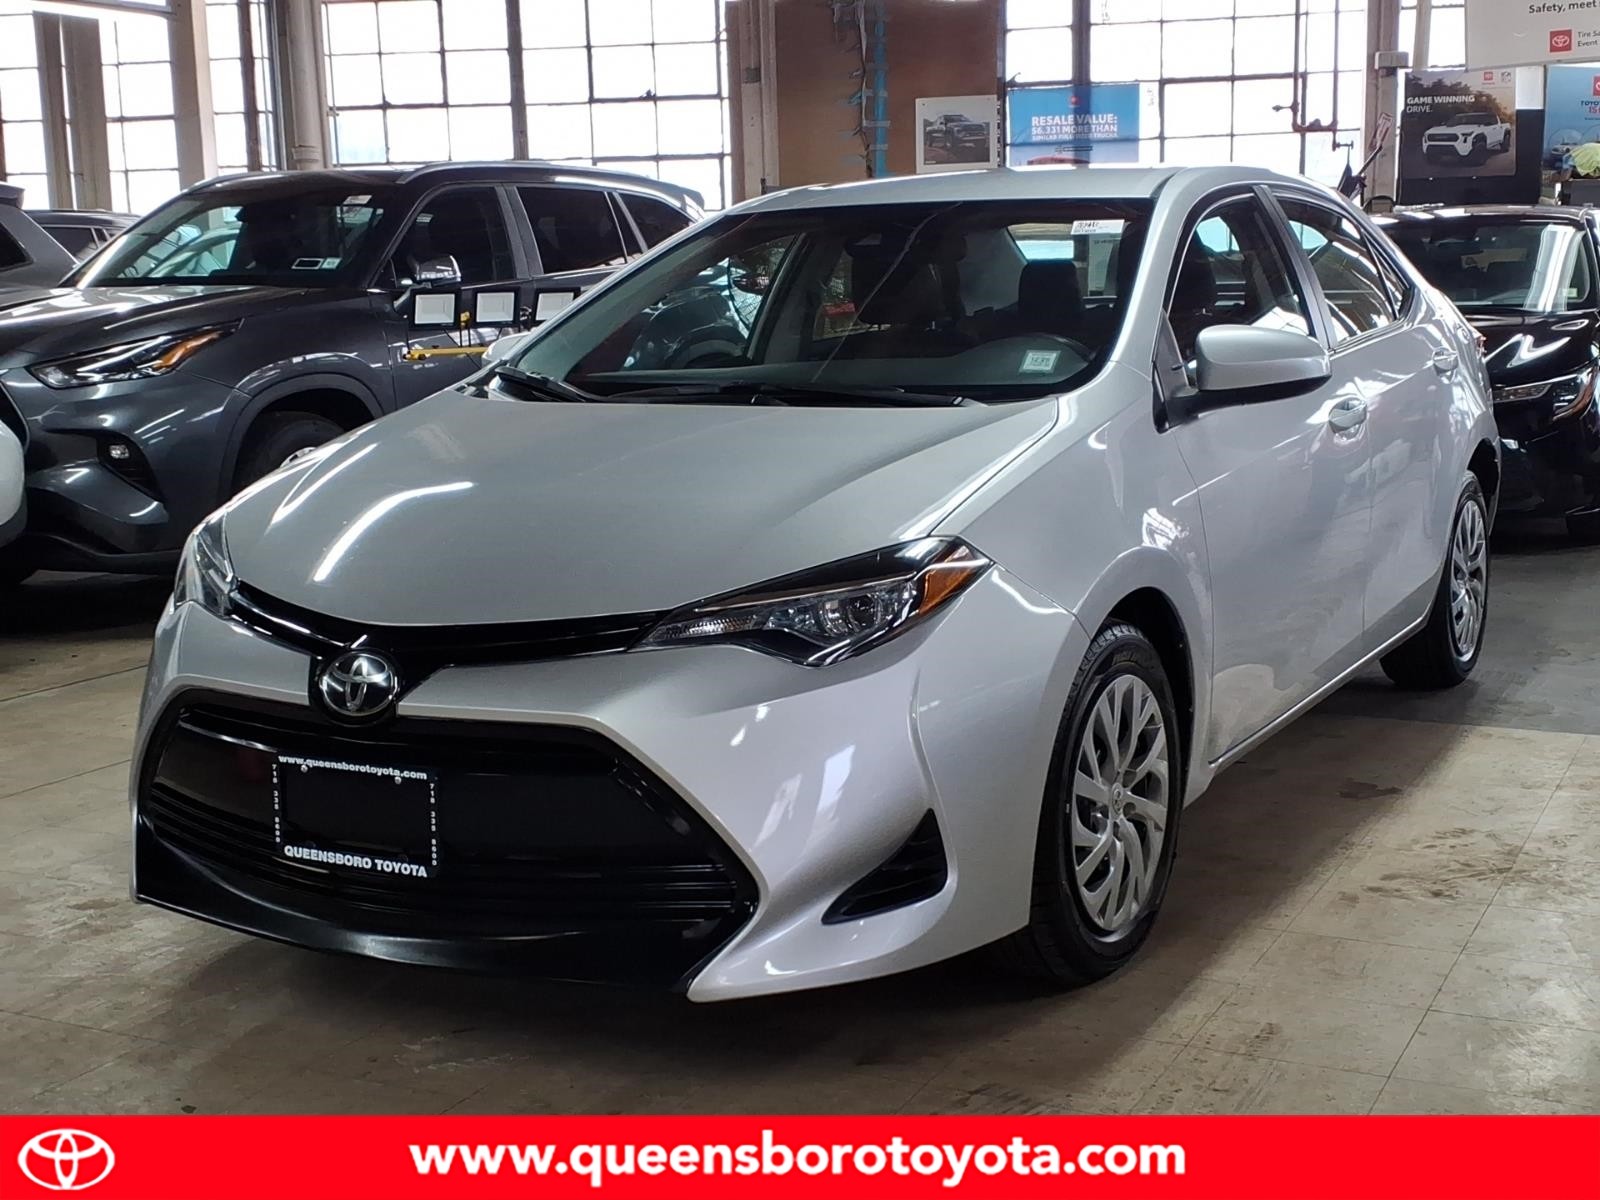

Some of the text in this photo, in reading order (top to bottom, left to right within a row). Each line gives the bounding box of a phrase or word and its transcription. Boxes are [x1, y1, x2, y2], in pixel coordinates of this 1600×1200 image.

[1528, 0, 1597, 14] Safety, meet
[1577, 39, 1598, 47] Event
[1406, 94, 1476, 105] GAME WINNING
[1406, 105, 1433, 113] DRIVE.
[1032, 113, 1118, 126] RESALE VALUE:
[1062, 125, 1090, 134] MORE
[1092, 124, 1118, 133] THAN
[278, 755, 428, 780] www.queensborotoyota.com
[284, 845, 428, 878] QUEENSBORO TOYOTA
